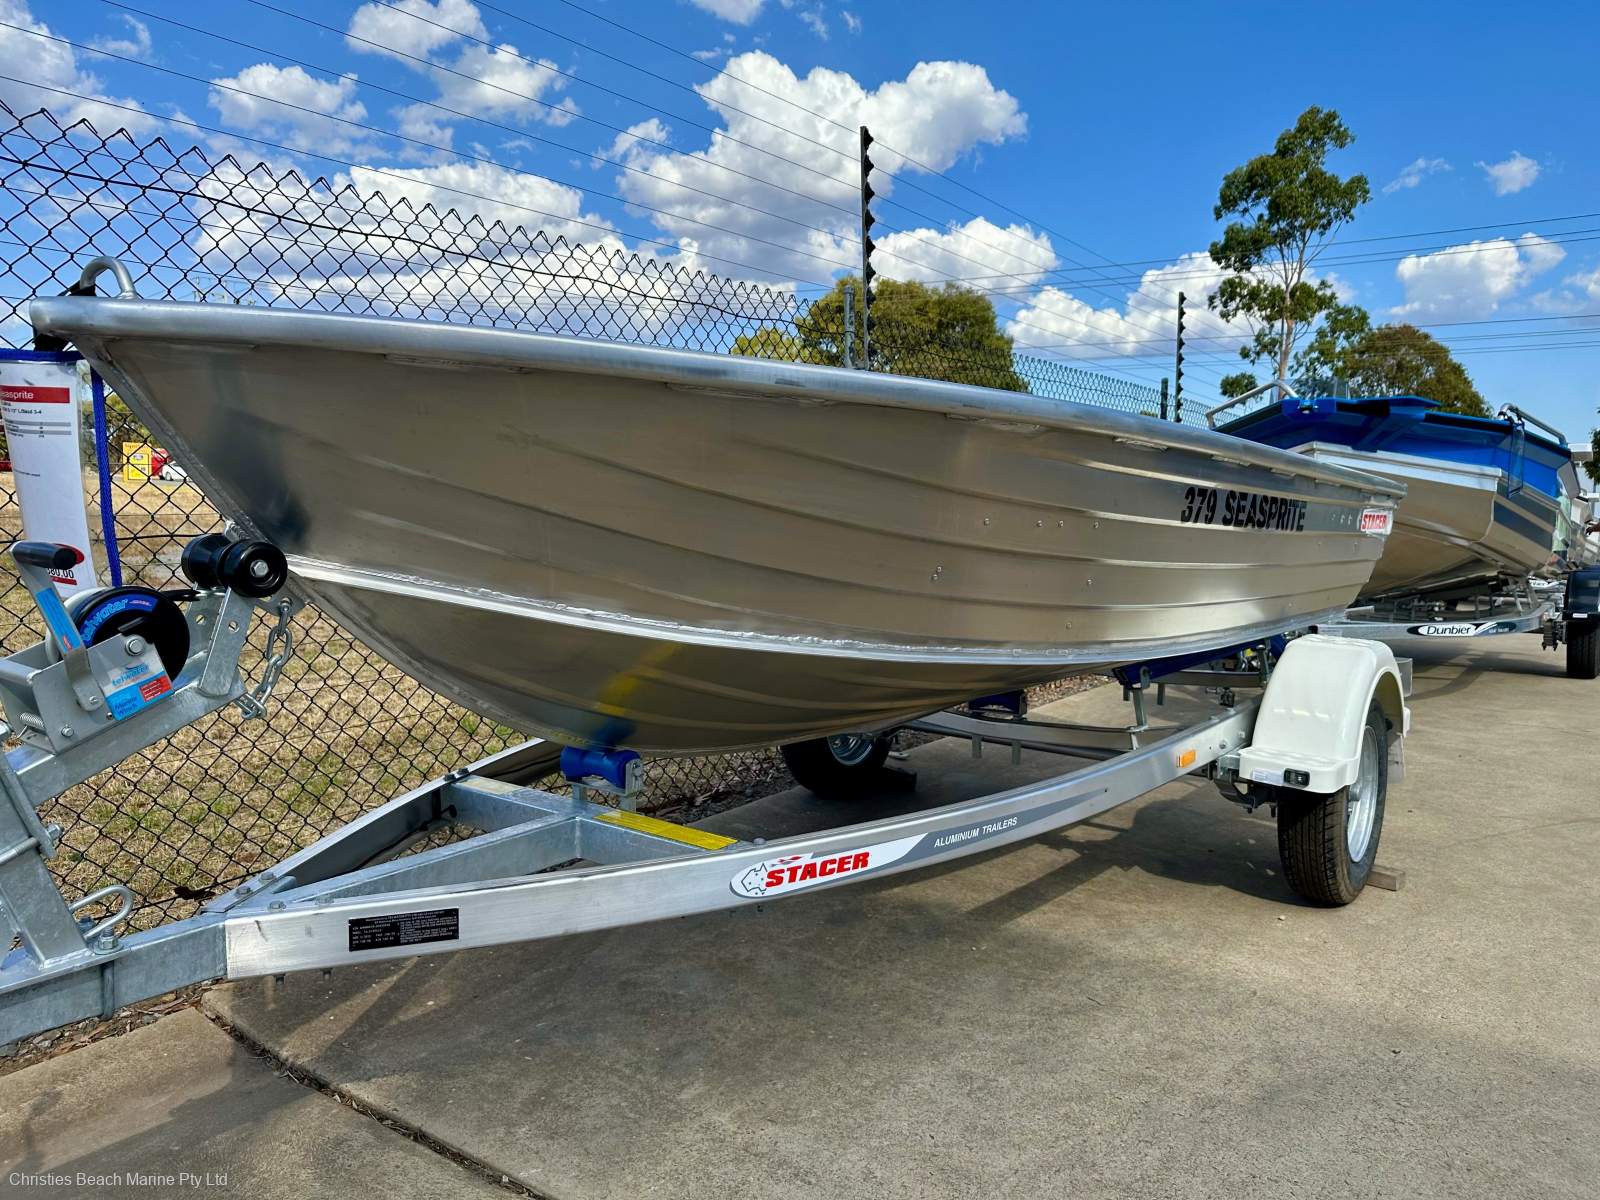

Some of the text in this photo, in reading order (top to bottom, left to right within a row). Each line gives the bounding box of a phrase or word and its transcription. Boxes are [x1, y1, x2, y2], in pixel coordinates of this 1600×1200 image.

[1181, 486, 1307, 531] 379 SEASPRITE
[1361, 514, 1388, 530] STACER
[1426, 624, 1471, 635] Dunbier
[934, 817, 1018, 848] ALUMINIUM TRAILERS
[765, 851, 870, 888] STACER
